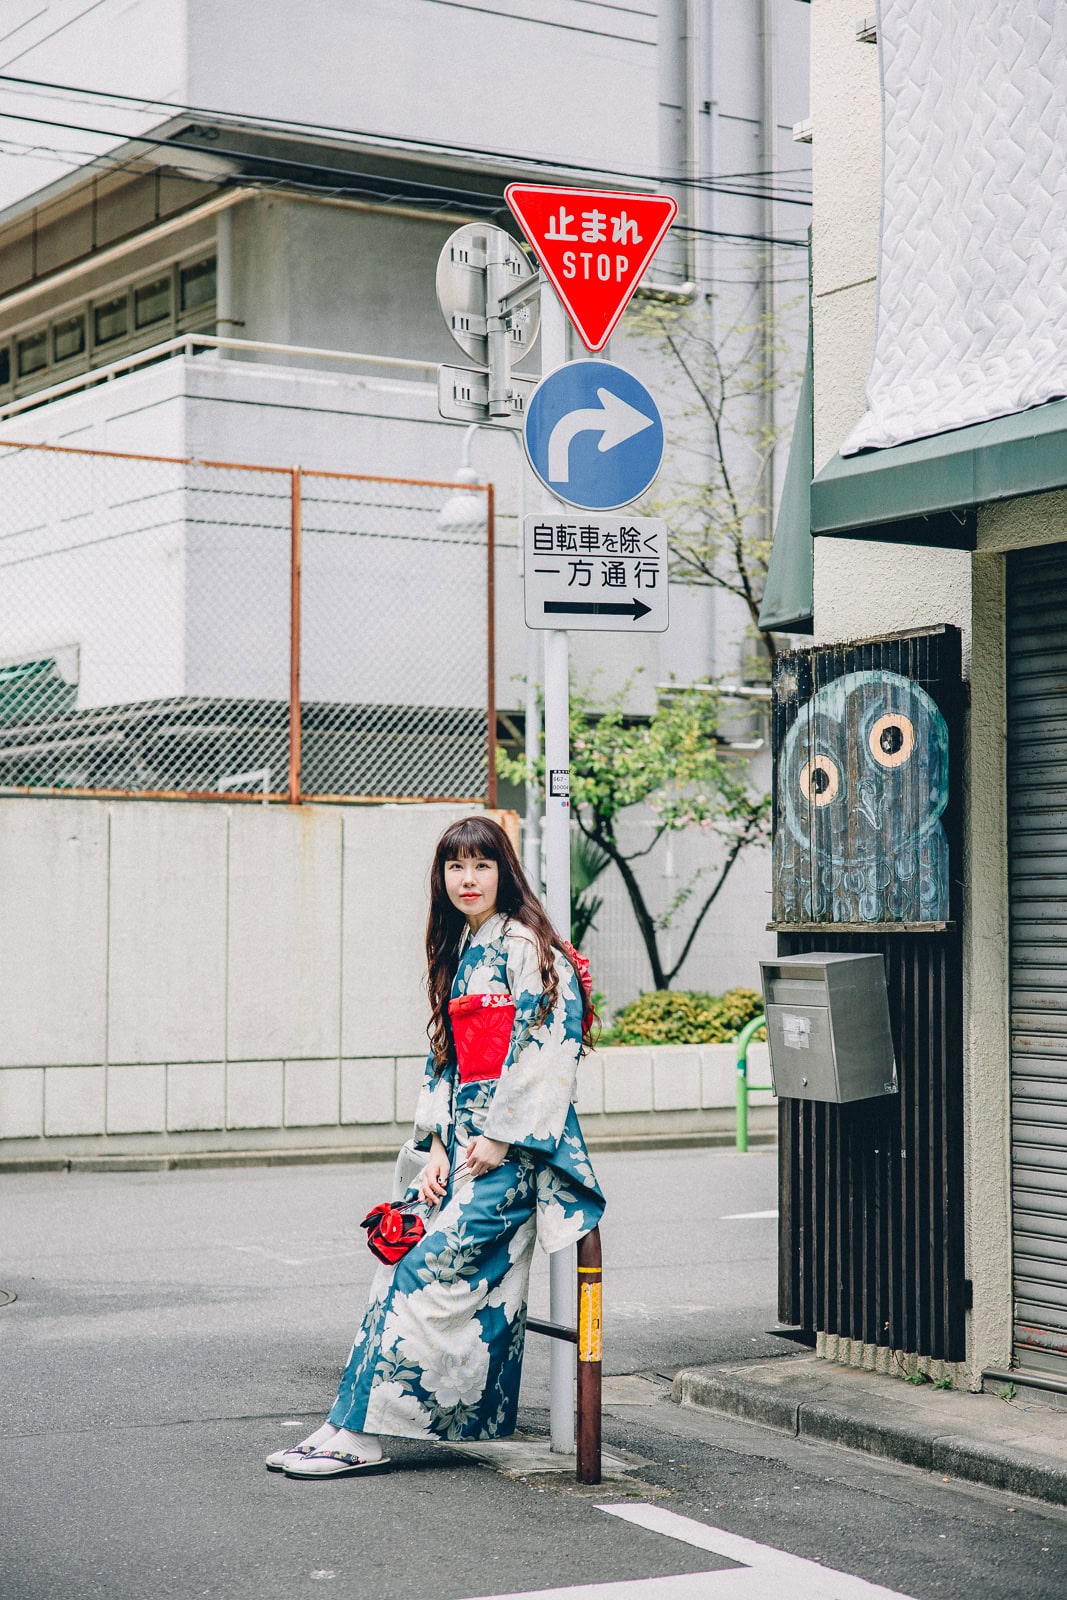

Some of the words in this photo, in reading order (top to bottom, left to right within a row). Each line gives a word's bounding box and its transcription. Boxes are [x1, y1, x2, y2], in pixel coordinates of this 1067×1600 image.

[544, 206, 643, 245] 止まれ
[562, 251, 629, 282] STOP
[533, 523, 658, 553] 自転車を除く
[534, 560, 660, 588] 一方通行
